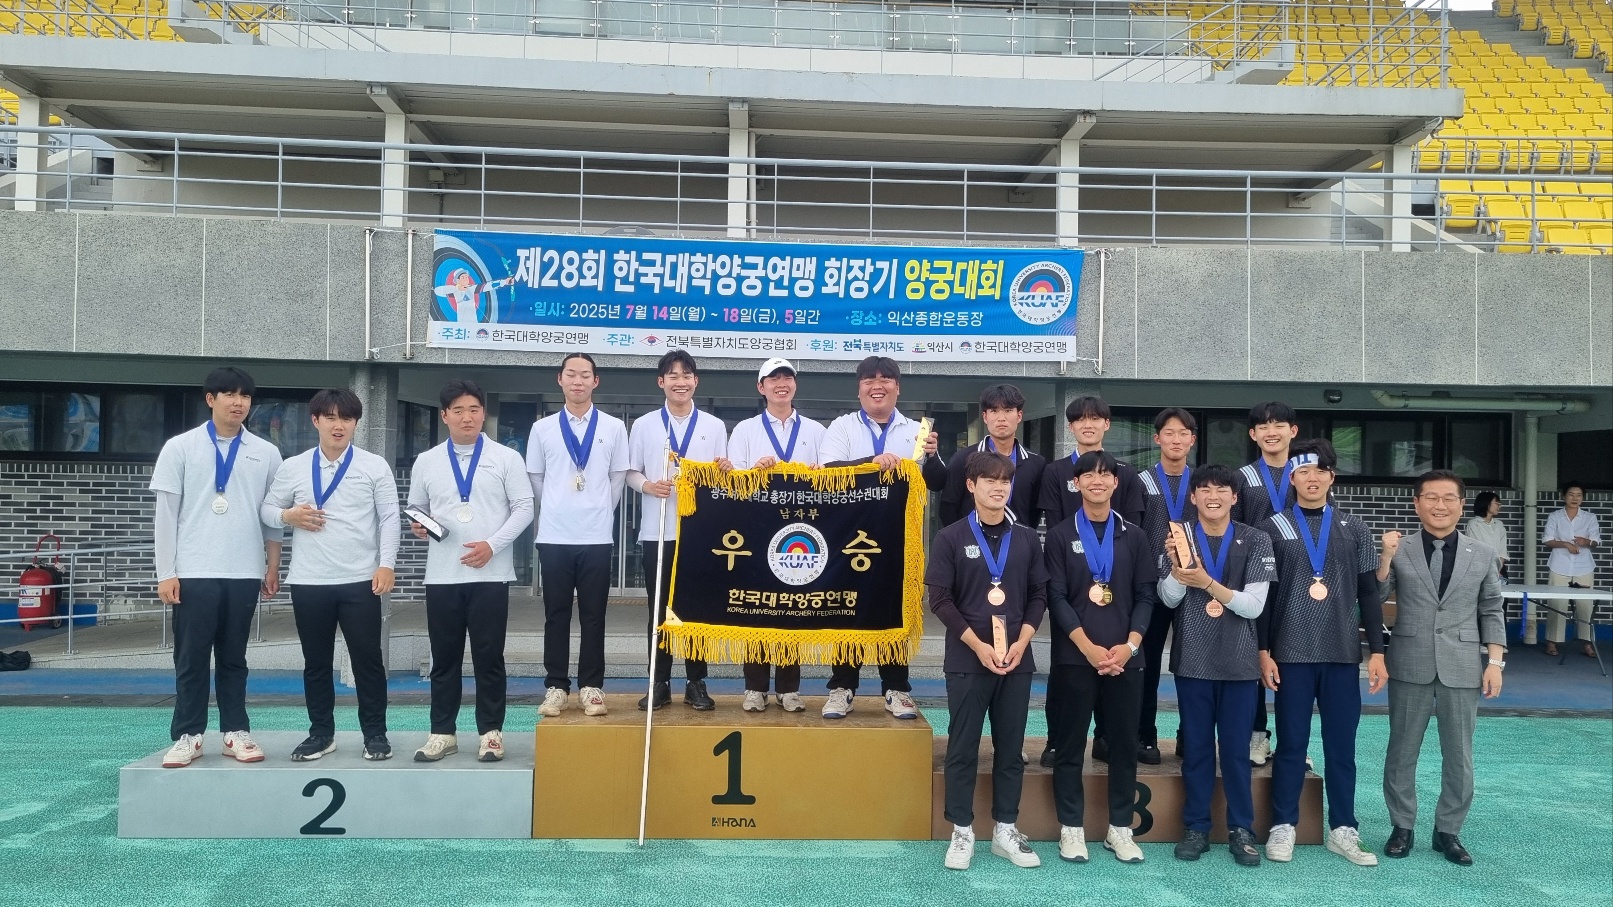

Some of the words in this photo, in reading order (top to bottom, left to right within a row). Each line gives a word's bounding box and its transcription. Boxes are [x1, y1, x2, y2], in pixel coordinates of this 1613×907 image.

[514, 247, 606, 291] 제28회
[613, 249, 817, 298] 한국대학양궁연맹
[821, 257, 898, 299] 회장기
[904, 259, 1005, 300] 양궁대회
[1017, 294, 1065, 308] KUAF
[570, 303, 621, 320] 2025년
[625, 304, 647, 321] 7월
[652, 304, 706, 322] 14일(월)
[723, 307, 779, 325] 18일(금),
[784, 309, 821, 325] 5일간
[887, 310, 983, 328] 익산종합운동장
[492, 329, 590, 345] 한국대학양궁연맹
[665, 335, 797, 351] 전북특별자치도양궁협회
[927, 341, 953, 353] 익산시
[974, 340, 1068, 354] 한국대학양궁연맹
[769, 491, 795, 505] 총장기
[796, 486, 889, 505] 한국대학양궁선수권대회
[711, 529, 752, 571] 우
[842, 529, 882, 572] 승
[778, 554, 819, 569] KUAF
[727, 588, 858, 609] 한국대학양궁연맹
[726, 605, 749, 615] KOREA
[749, 607, 786, 616] UNIVERSITY
[786, 608, 816, 617] ARCHERY
[816, 608, 856, 617] FEDERATION
[711, 730, 756, 805] 1
[300, 777, 346, 835] 2
